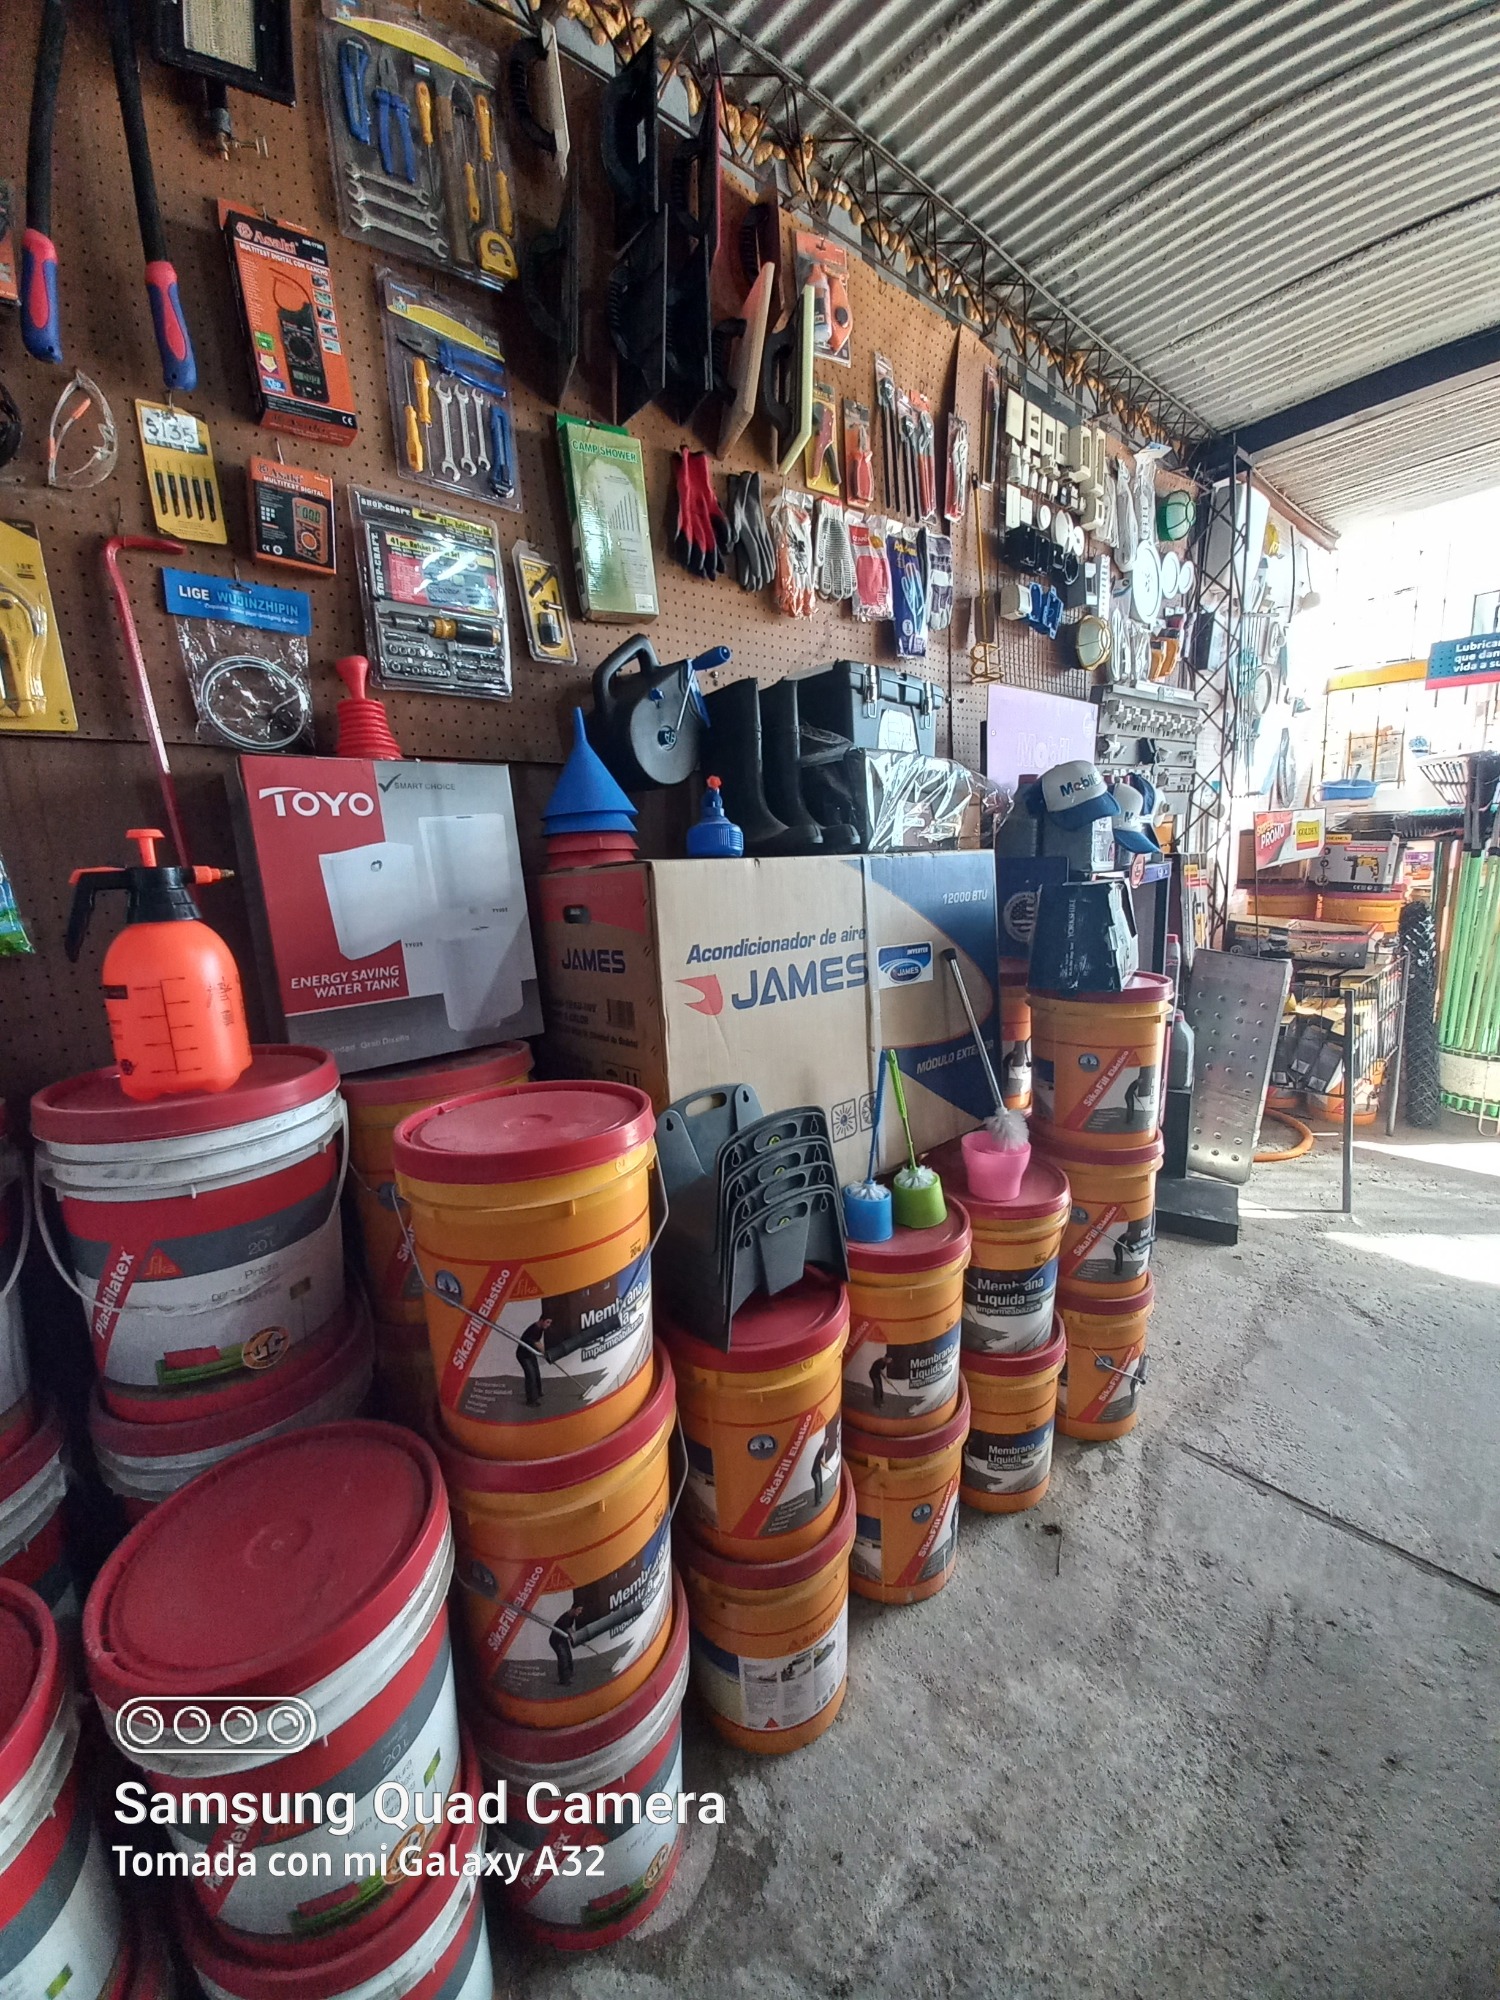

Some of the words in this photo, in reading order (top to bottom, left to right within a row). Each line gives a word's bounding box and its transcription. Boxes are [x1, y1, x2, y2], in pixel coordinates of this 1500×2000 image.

[239, 242, 271, 258] MULTITEST
[270, 252, 293, 265] DIGITAL
[253, 230, 298, 255] Asaki
[572, 440, 598, 453] CAMP
[600, 445, 637, 462] SHOWER
[263, 475, 299, 491] MULTITEST
[300, 485, 326, 498] DIGITAL
[360, 499, 411, 516] SHOP-CRAFT
[370, 532, 385, 595] SHOP-CRAFT
[179, 585, 210, 600] LIGE
[217, 592, 298, 617] WUJINZHIPIN
[1454, 653, 1476, 664] que
[1455, 640, 1500, 653] Lubrica
[1453, 662, 1477, 673] vida
[394, 781, 424, 791] SMART
[425, 783, 456, 791] CHOICE
[259, 787, 374, 816] TOYO
[1260, 823, 1286, 850] PROMO
[942, 892, 971, 905] 12000
[972, 889, 988, 902] BTU
[686, 931, 816, 964] Acondicionador
[820, 928, 836, 946] de
[841, 926, 866, 943] aire
[906, 946, 929, 956] INVERTER
[562, 949, 626, 974] JAMES
[897, 966, 920, 977] JAMES
[291, 971, 348, 989] ENERGY
[352, 965, 399, 980] SAVING
[315, 984, 361, 998] WATER
[367, 977, 399, 991] TANK
[731, 952, 869, 1010] JAMES
[1083, 1075, 1110, 1107] SikaFill
[1073, 1227, 1099, 1256] SikaFill
[146, 1257, 177, 1276] Sika
[95, 1251, 134, 1339] Plastilatex
[452, 1315, 485, 1370] SikaFill
[479, 1268, 510, 1318] Elástico
[910, 1344, 955, 1370] Membrana
[909, 1361, 943, 1380] Líquida
[759, 1459, 792, 1505] SikaFill
[789, 1414, 812, 1456] Elástico
[988, 1443, 1035, 1454] Membrana
[988, 1454, 1022, 1464] Líquida
[918, 1517, 942, 1558] SikaFill
[488, 1607, 519, 1651] SikaFill
[514, 1566, 544, 1610] Elástico
